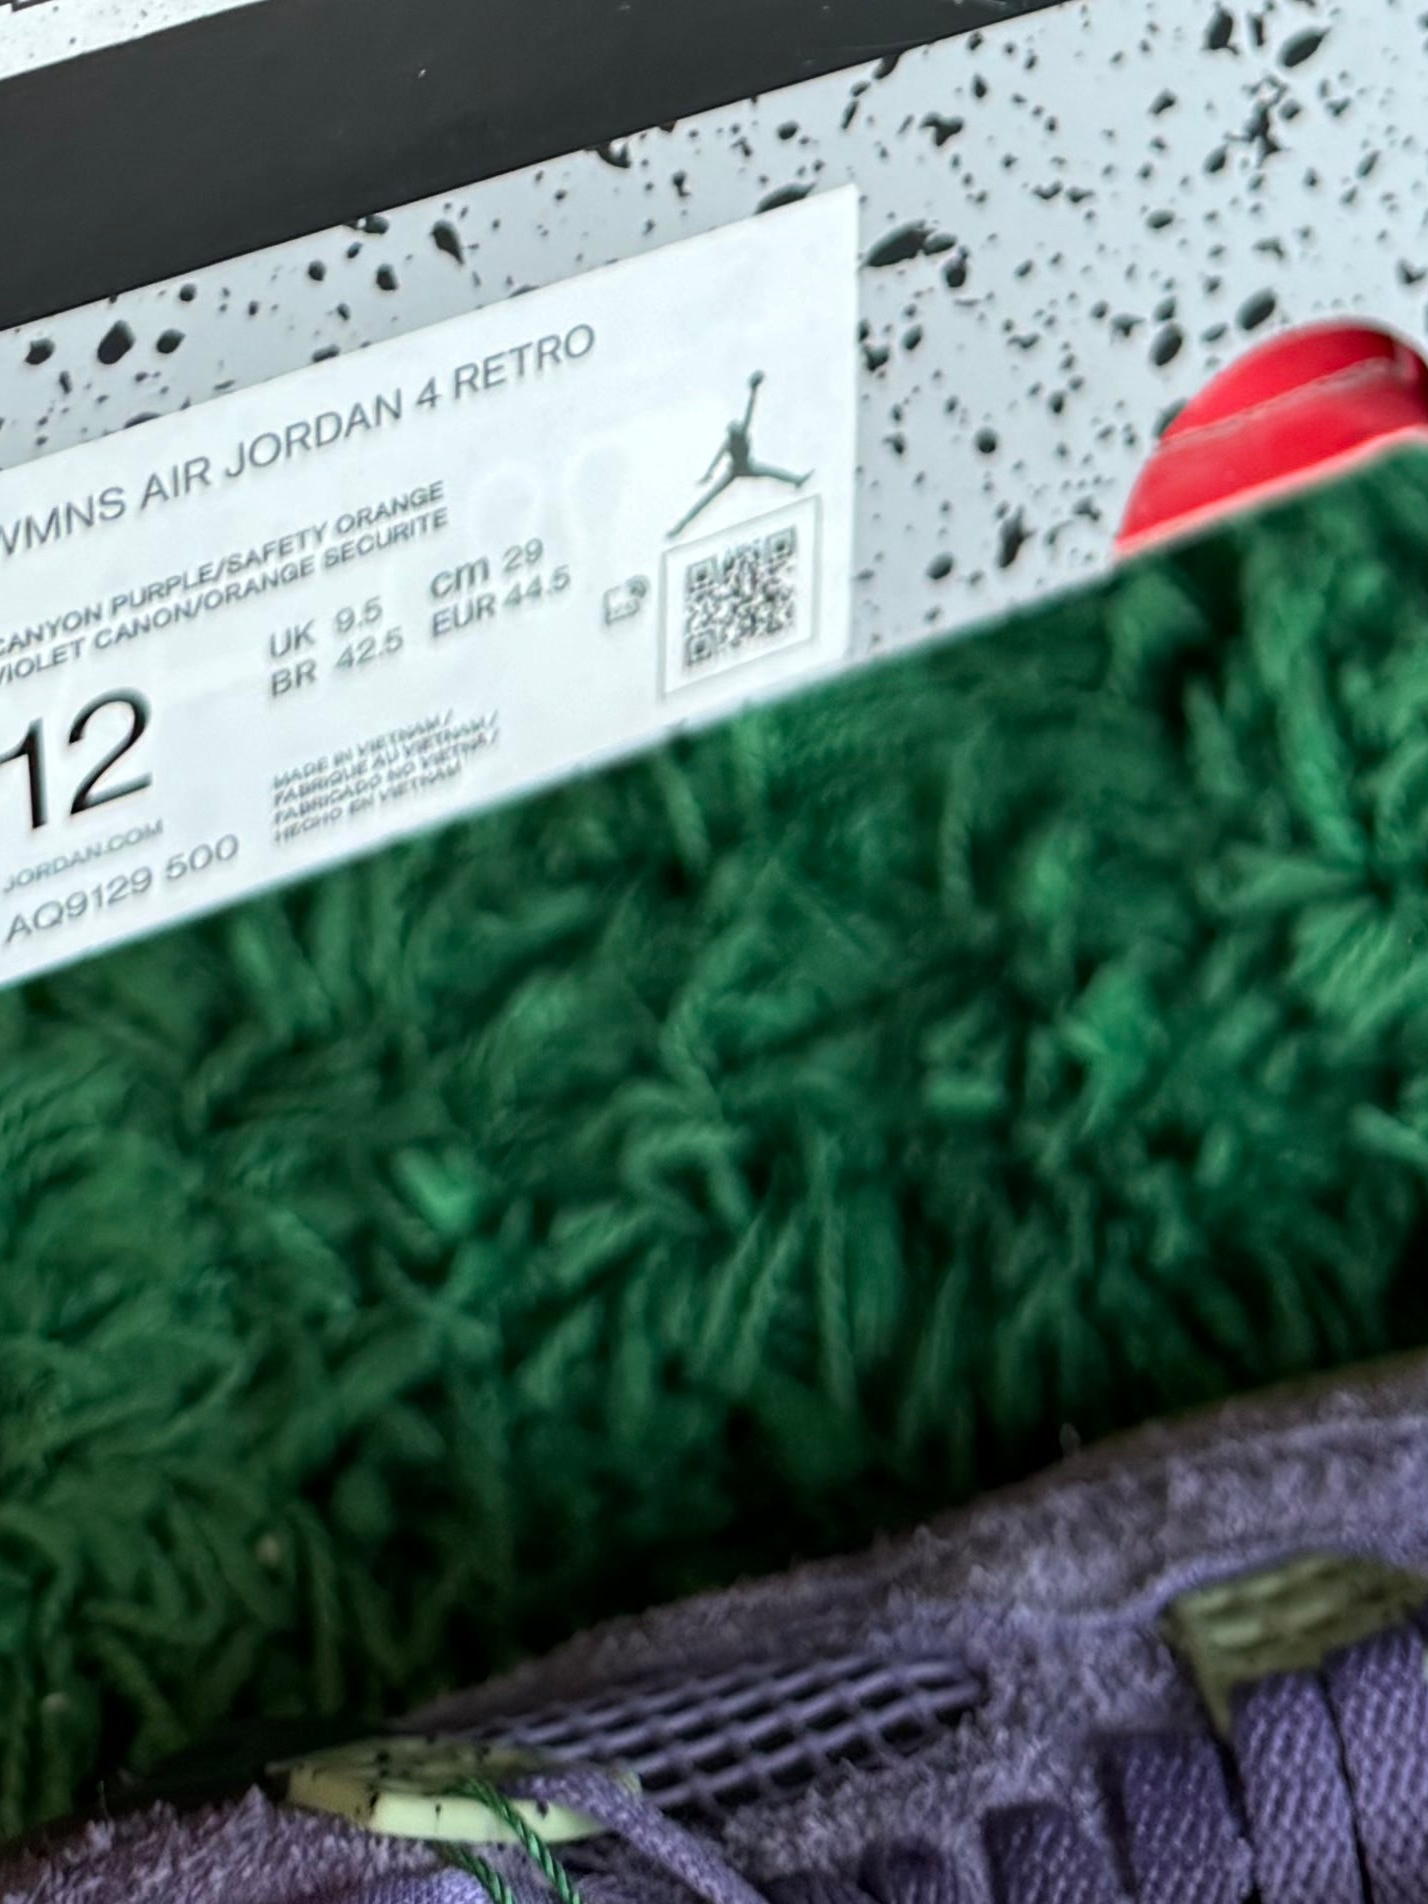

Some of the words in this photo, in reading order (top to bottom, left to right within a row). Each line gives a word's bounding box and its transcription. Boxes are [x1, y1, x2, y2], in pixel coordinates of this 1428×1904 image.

[139, 456, 213, 511] AIR
[224, 388, 401, 479] JORDAN
[415, 376, 440, 408] 4
[453, 323, 595, 400] RETRO
[92, 555, 314, 650] CANON/ORANGE
[322, 507, 447, 570] SECURITE
[110, 521, 327, 617] PURPLE/SAFETY
[334, 480, 443, 535] ORANGE
[429, 557, 489, 600] cm
[502, 537, 543, 577] 29
[269, 619, 314, 659] UK
[334, 595, 382, 635] 9.5
[430, 593, 495, 640] EUR
[502, 564, 570, 610] 44.5
[270, 659, 316, 698] BR
[334, 626, 404, 672] 42.5
[2, 818, 163, 896] JORDAN.COM
[4, 866, 153, 945] AQ9129
[164, 834, 238, 883] 500
